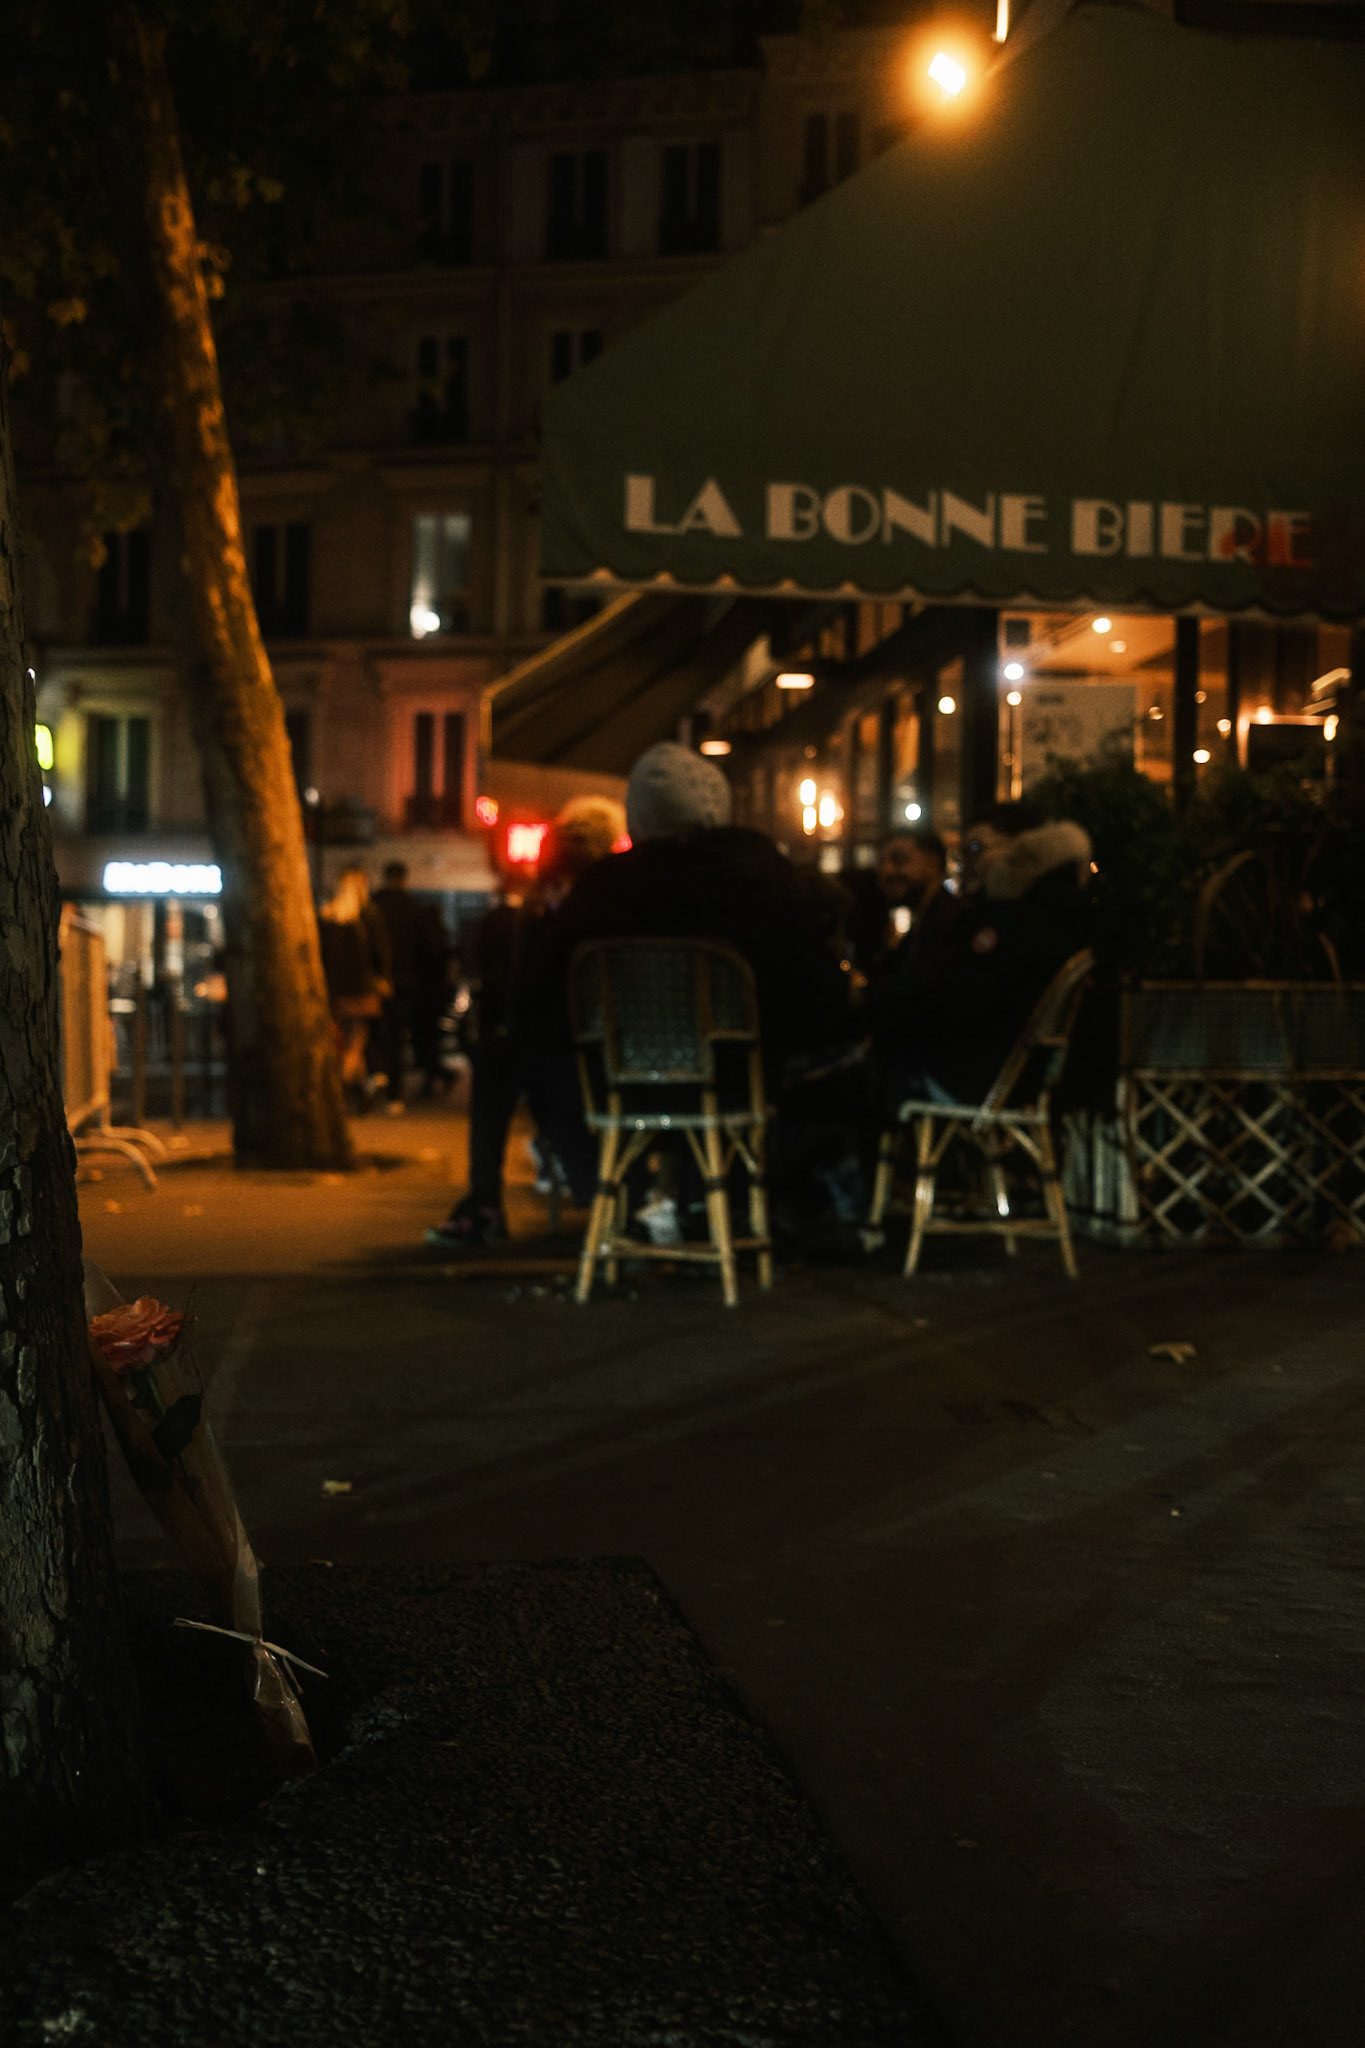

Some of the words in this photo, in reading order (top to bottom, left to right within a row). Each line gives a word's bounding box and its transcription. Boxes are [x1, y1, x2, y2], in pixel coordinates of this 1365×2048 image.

[625, 473, 743, 538] LA
[766, 481, 1047, 552] BONNE
[1071, 498, 1313, 567] BIERE
